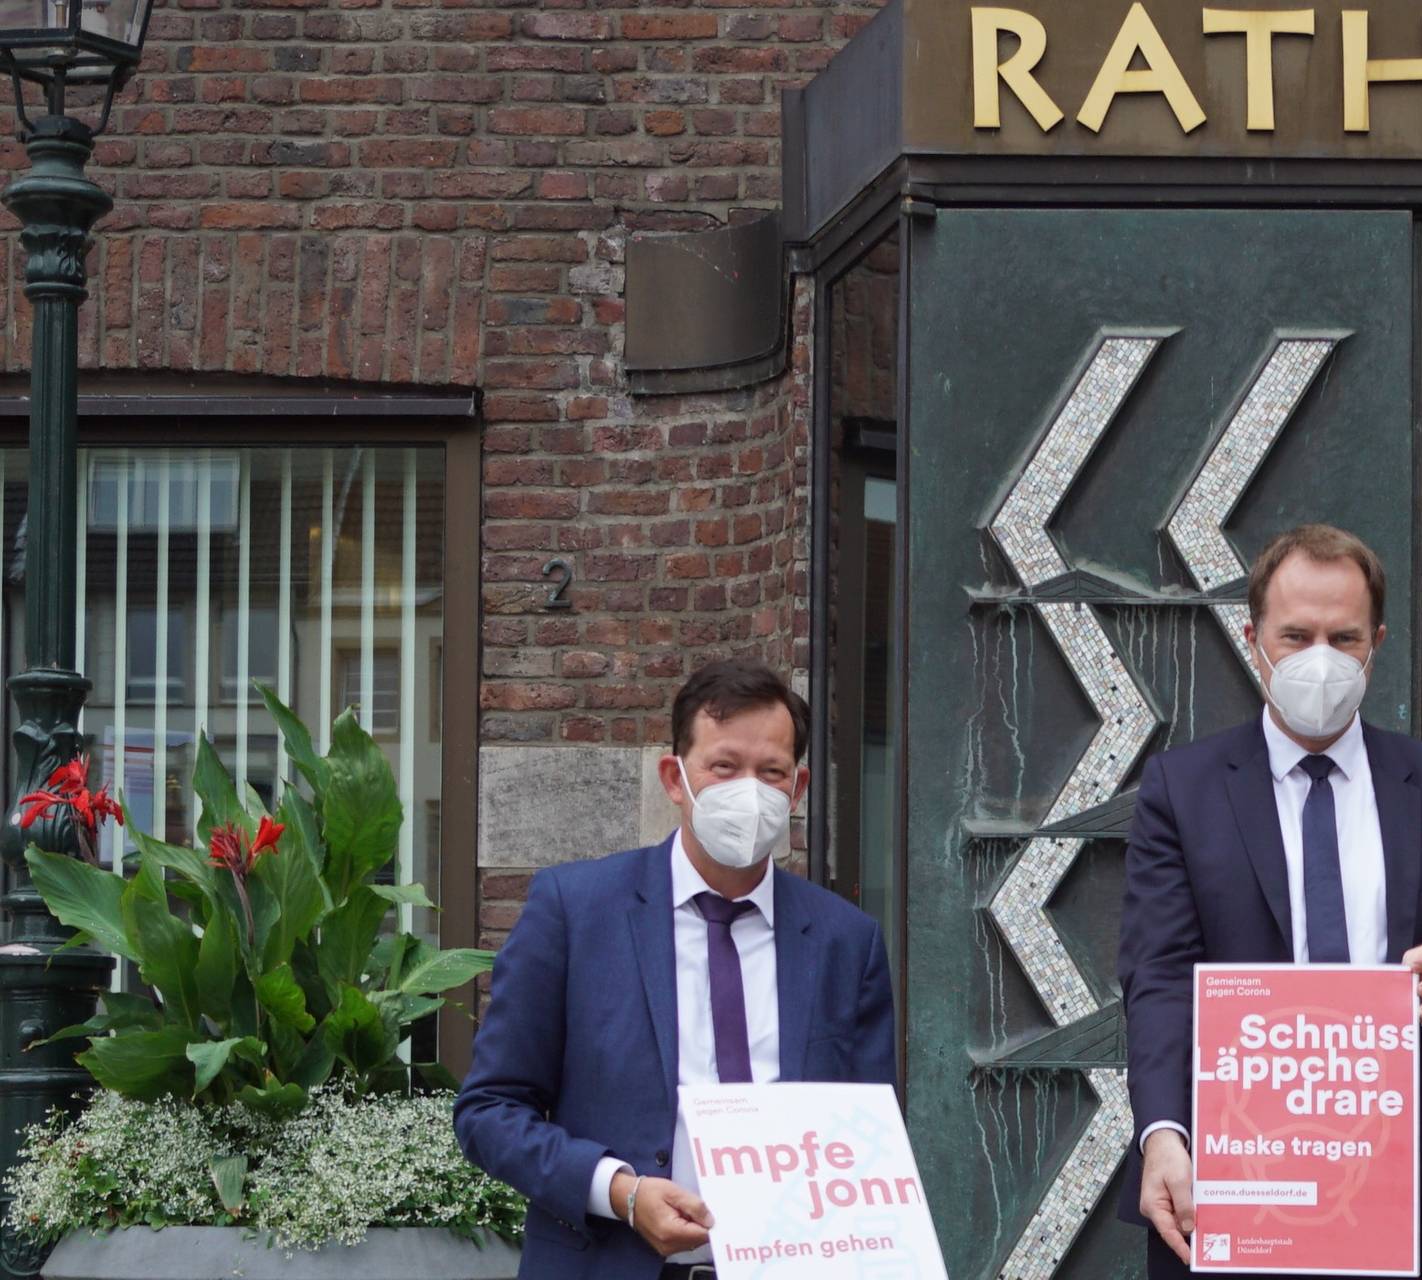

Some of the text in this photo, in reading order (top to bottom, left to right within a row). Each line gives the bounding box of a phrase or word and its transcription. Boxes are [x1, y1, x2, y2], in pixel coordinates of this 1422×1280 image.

[543, 558, 572, 608] 2
[1206, 976, 1262, 986] Gemeinsam
[1206, 987, 1271, 998] gegen Corona
[1240, 1013, 1416, 1050] Schnüss
[1197, 1046, 1380, 1090] Läppche
[1286, 1080, 1404, 1116] drare
[694, 1130, 855, 1183] Impfe
[1205, 1134, 1373, 1161] Maske tragen
[1204, 1188, 1308, 1197] corona.duesseldorf.de
[726, 1234, 894, 1263] Impfen gehen
